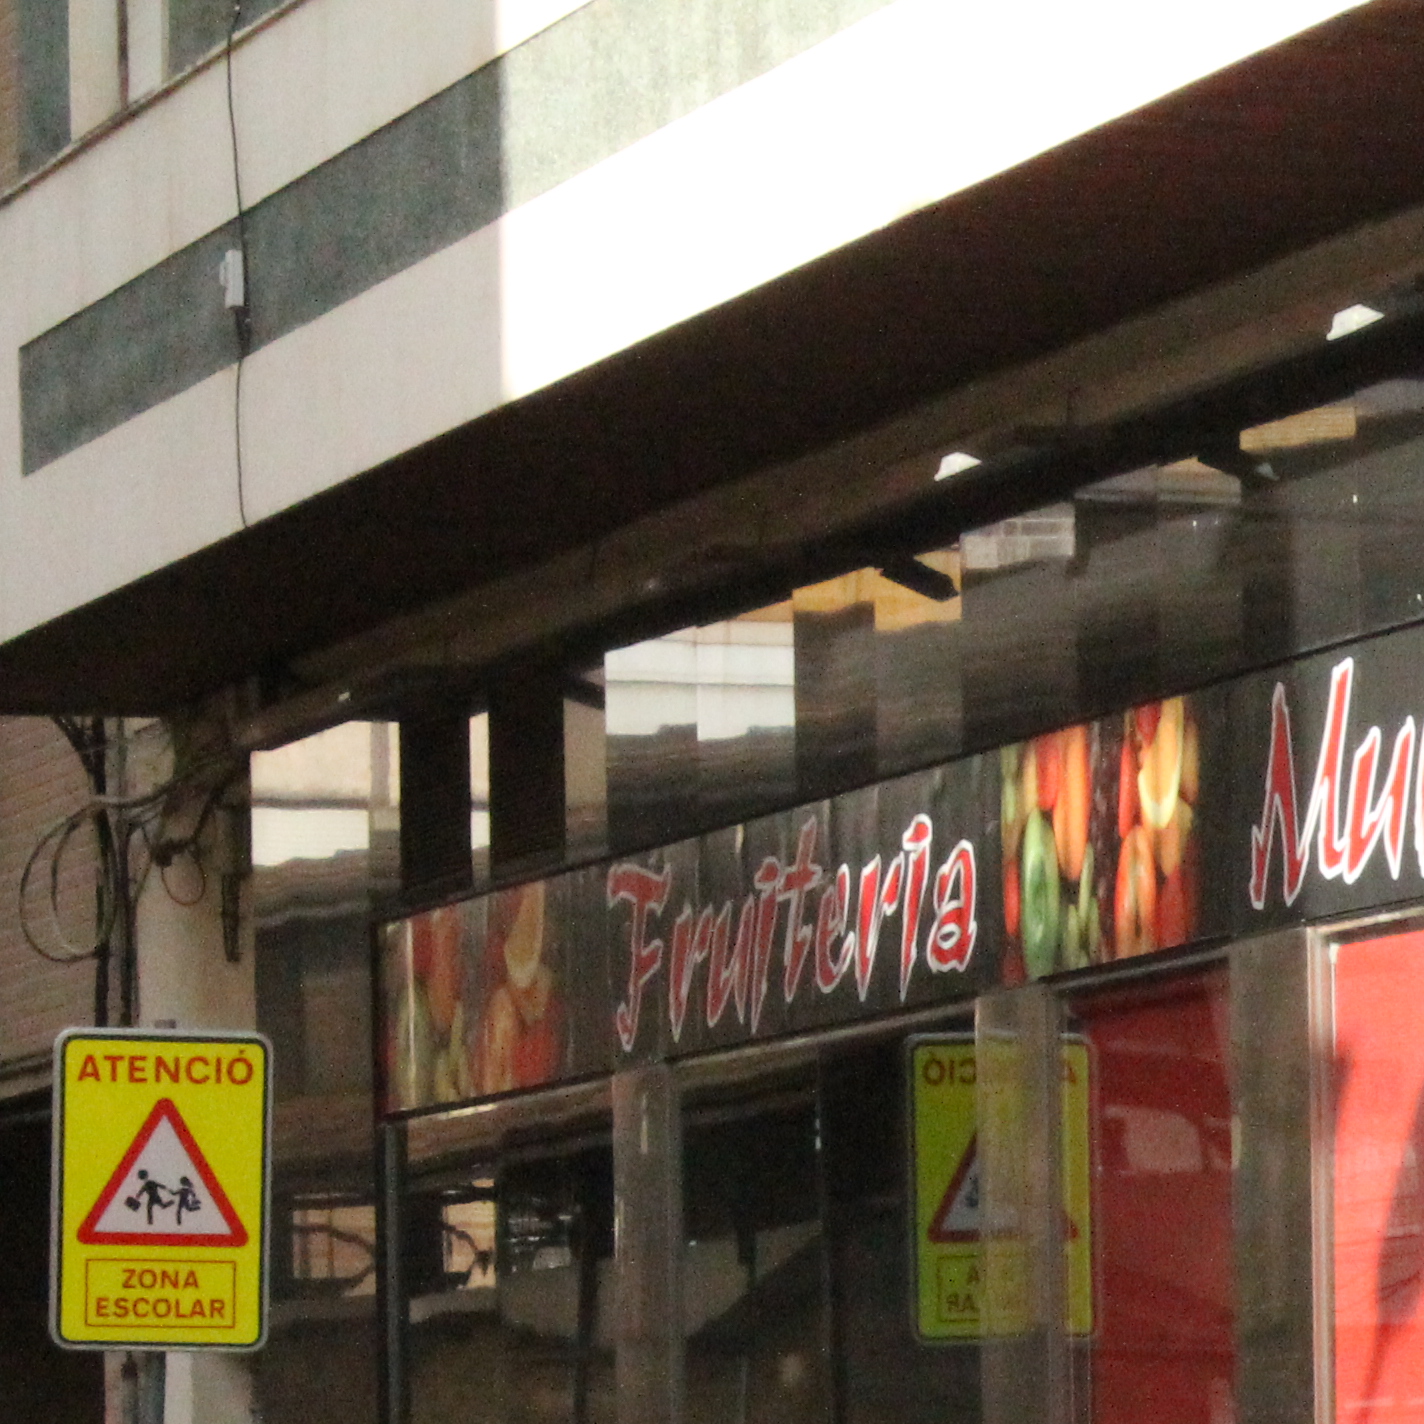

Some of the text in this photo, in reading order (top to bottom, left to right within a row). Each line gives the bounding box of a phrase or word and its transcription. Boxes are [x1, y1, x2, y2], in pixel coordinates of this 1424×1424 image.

[606, 813, 977, 1052] Fruiteria
[77, 1048, 254, 1086] ATENCIÓ
[121, 1268, 199, 1289] ZONA
[94, 1297, 226, 1319] ESCOLAR
